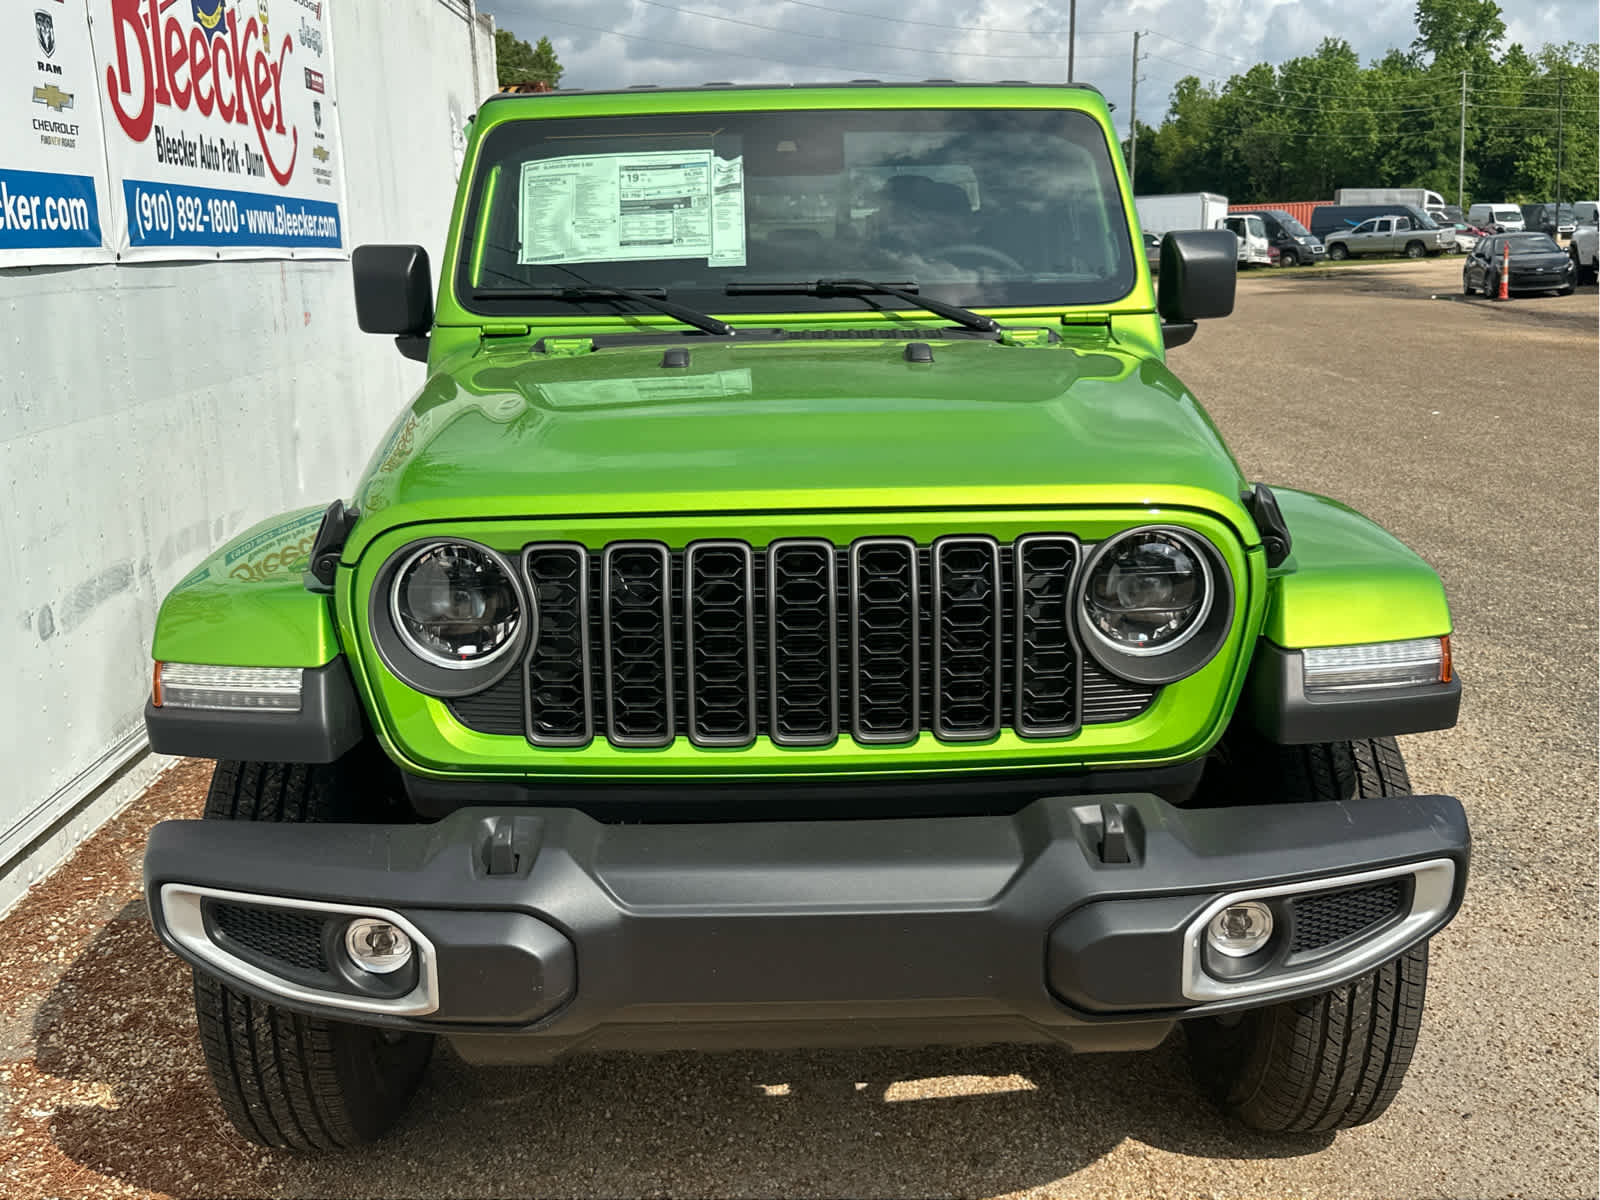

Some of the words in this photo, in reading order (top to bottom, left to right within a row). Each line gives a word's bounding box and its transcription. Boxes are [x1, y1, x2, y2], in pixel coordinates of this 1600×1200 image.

[37, 61, 62, 75] RAM
[107, 0, 297, 186] Bleecker
[32, 118, 79, 135] CHEVROLET
[154, 125, 197, 168] Bleecker
[199, 133, 219, 171] Auto
[220, 138, 241, 174] Park
[244, 143, 265, 177] Dunn
[136, 187, 174, 240] (910)
[176, 195, 239, 233] 892-1800
[246, 203, 338, 238] www.Bleecker.com
